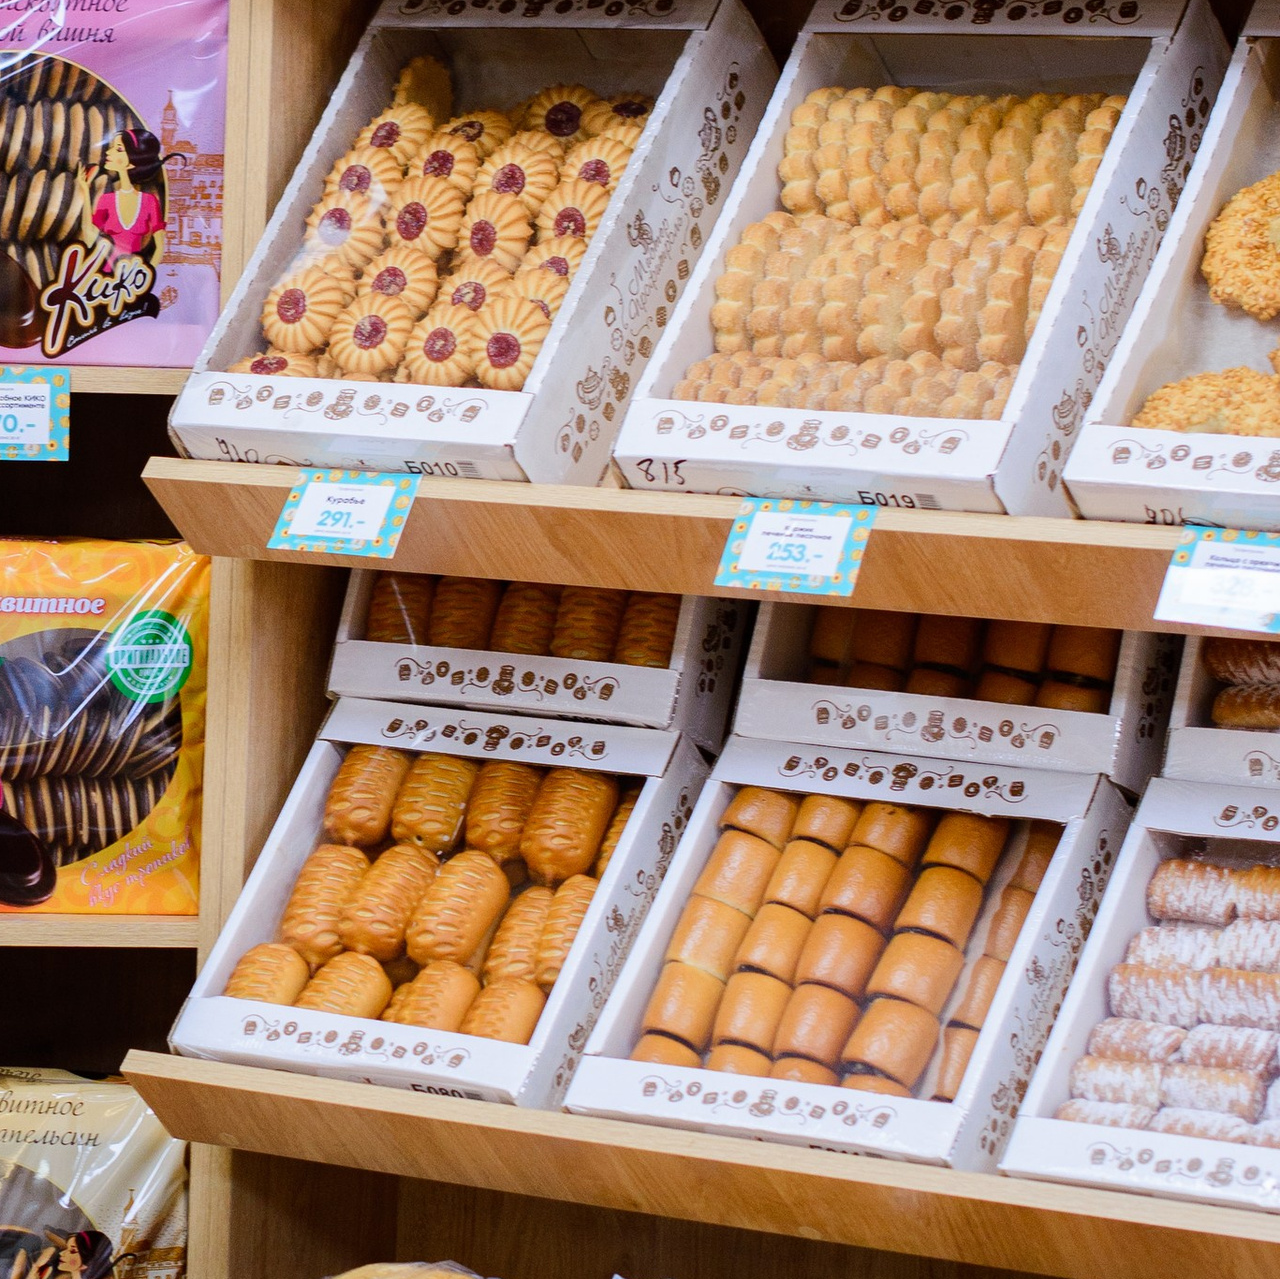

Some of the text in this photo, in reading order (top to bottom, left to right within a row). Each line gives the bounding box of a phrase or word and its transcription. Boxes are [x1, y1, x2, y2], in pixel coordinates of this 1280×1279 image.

[37, 21, 116, 43] вишня
[404, 460, 458, 476] Б010
[326, 496, 366, 505] Курабье
[857, 490, 916, 508] Б019
[316, 510, 365, 528] 291.-
[81, 836, 153, 885] Сладкий
